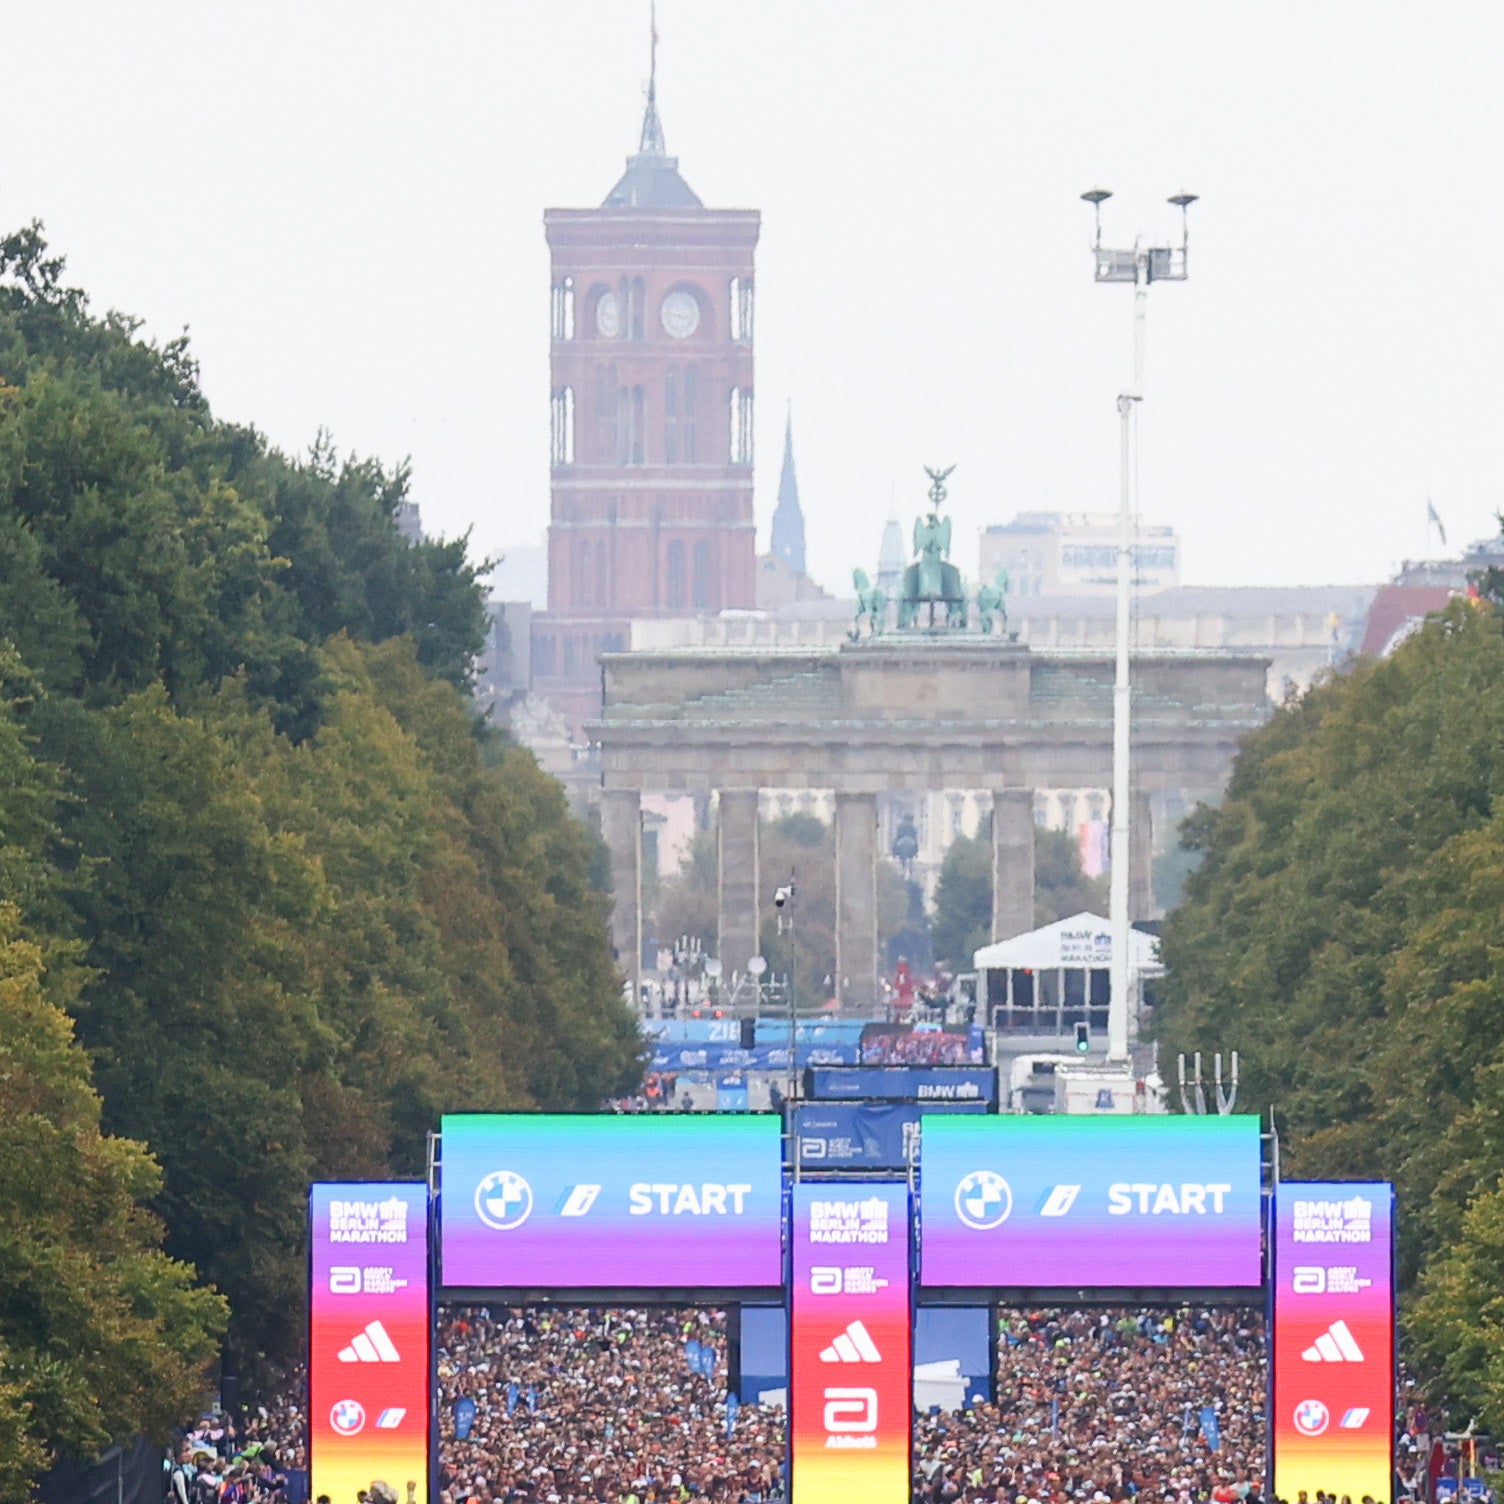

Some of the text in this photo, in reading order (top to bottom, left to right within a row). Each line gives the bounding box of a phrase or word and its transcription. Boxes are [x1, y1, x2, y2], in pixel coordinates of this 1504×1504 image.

[629, 1183, 752, 1215] START
[1108, 1183, 1231, 1215] START
[330, 1201, 378, 1218] BMW
[810, 1201, 859, 1218] BMW
[1294, 1201, 1343, 1218] BMW
[330, 1218, 379, 1230] BERLIN
[810, 1218, 860, 1230] BERLIN
[1293, 1218, 1343, 1230] BERLIN
[330, 1230, 407, 1243] MARATHON
[810, 1230, 888, 1243] MARATHON
[1293, 1230, 1371, 1243] MARATHON
